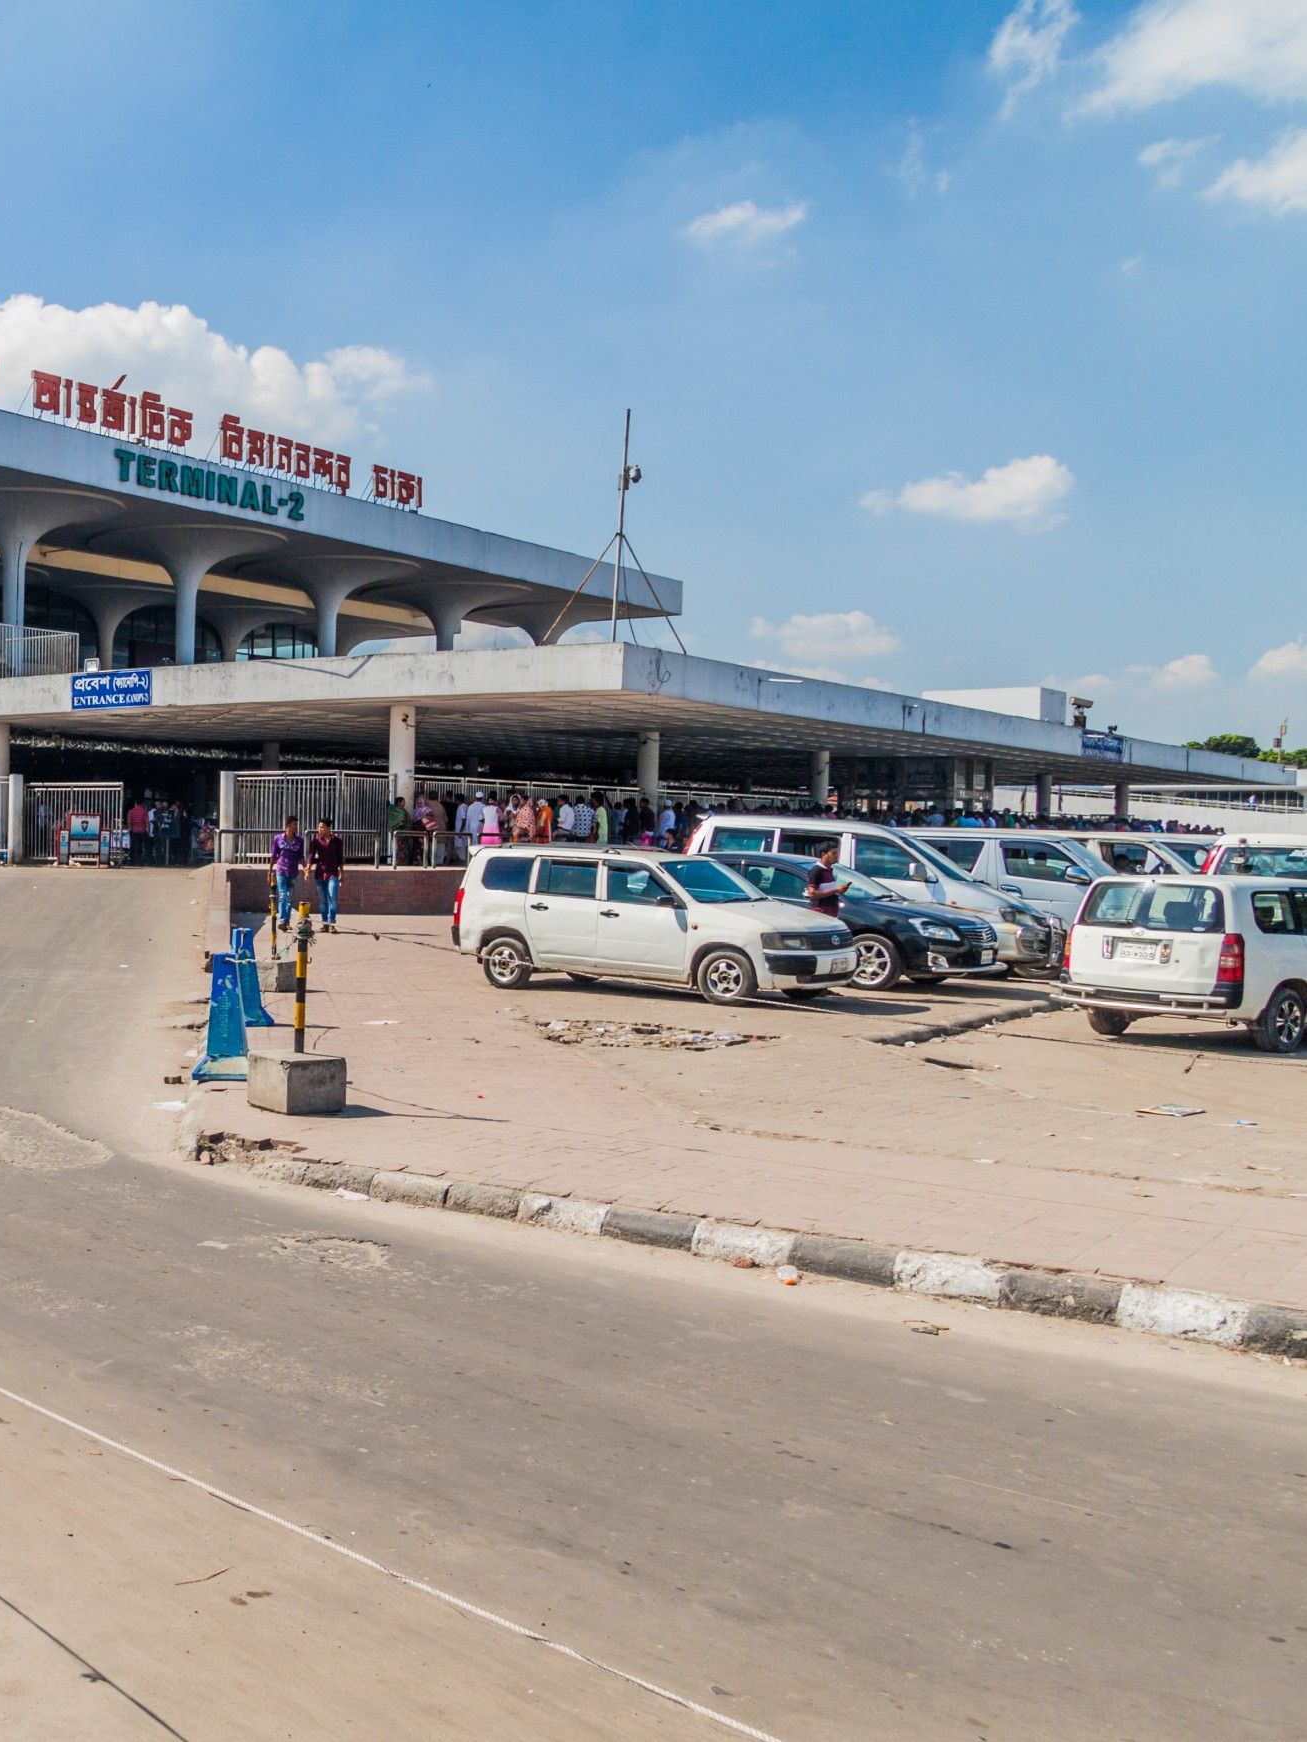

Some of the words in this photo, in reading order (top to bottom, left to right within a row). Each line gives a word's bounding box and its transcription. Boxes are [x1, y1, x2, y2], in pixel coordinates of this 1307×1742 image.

[220, 413, 351, 496] বিমানবন্দর
[372, 464, 423, 508] ঢাকা
[114, 448, 305, 522] TERMINAL-2
[73, 694, 126, 706] ENTRANCE
[74, 675, 111, 692] প্রবেশ
